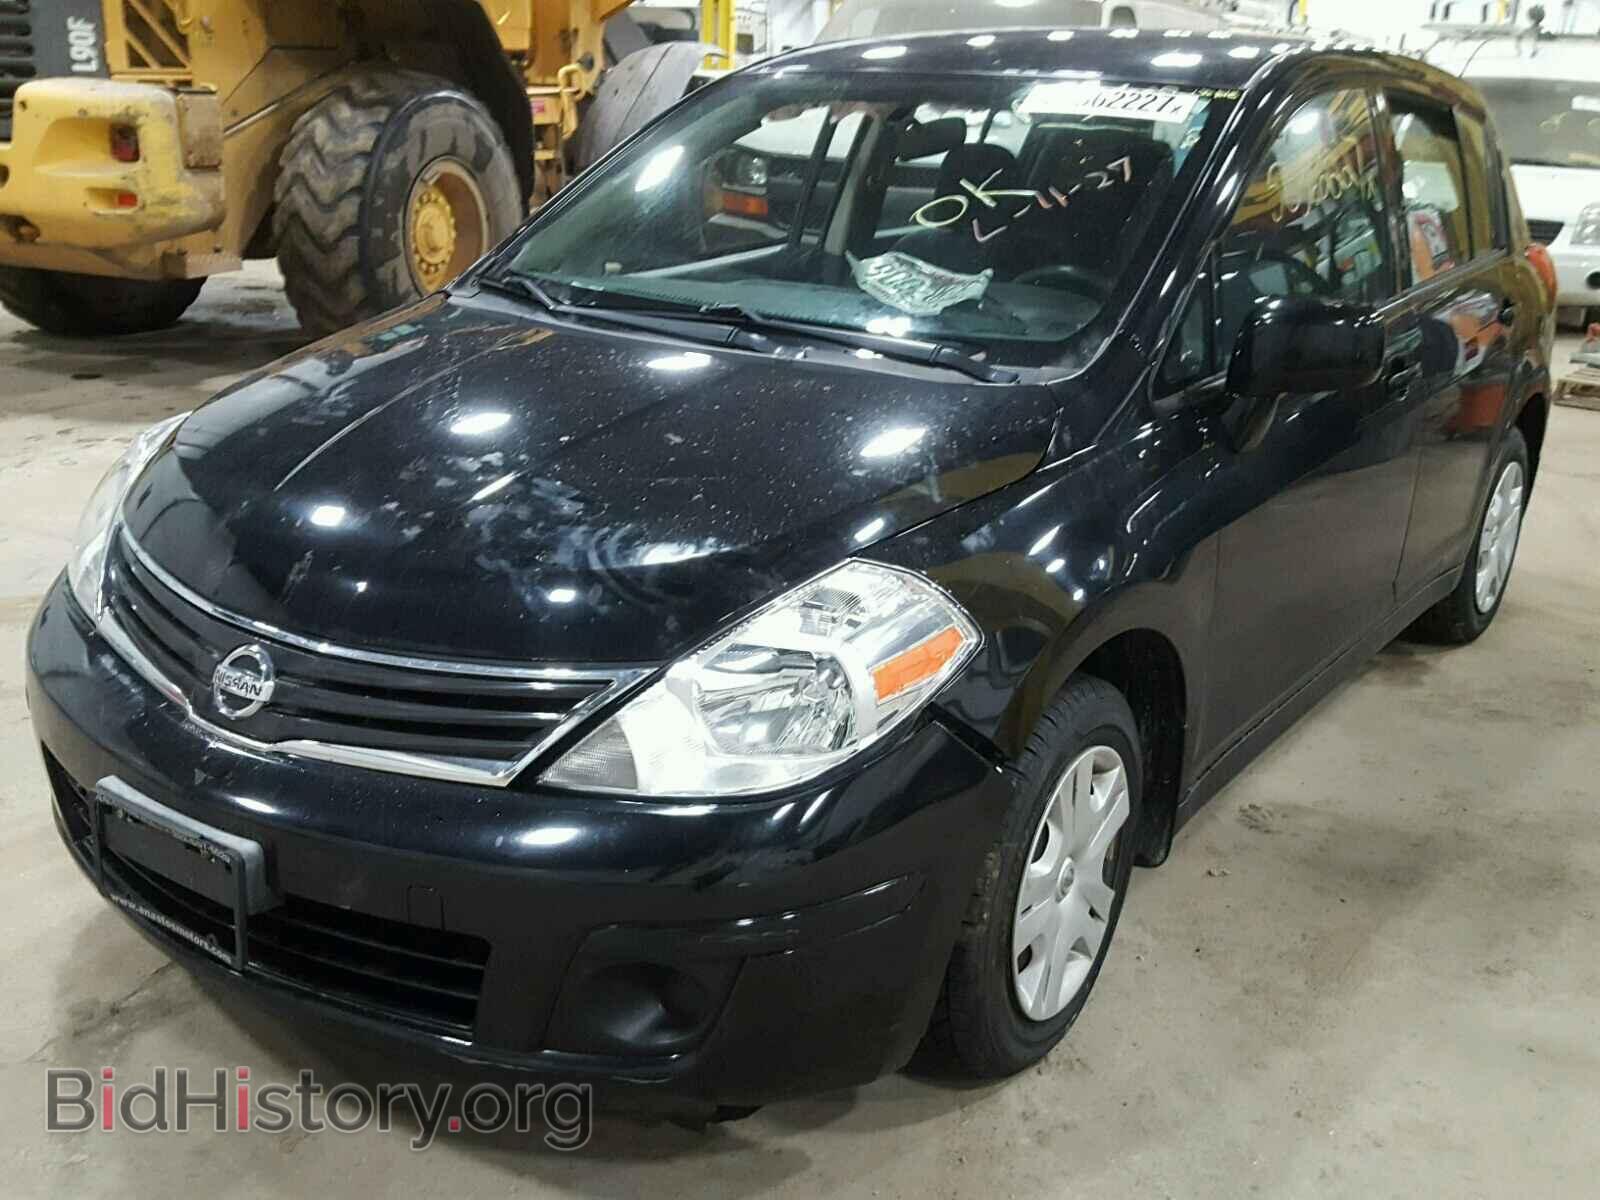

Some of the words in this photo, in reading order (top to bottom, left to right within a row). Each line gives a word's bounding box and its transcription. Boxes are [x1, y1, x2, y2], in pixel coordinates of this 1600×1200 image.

[66, 15, 98, 72] L90F
[909, 168, 1037, 228] OK
[214, 668, 263, 697] NISSAN
